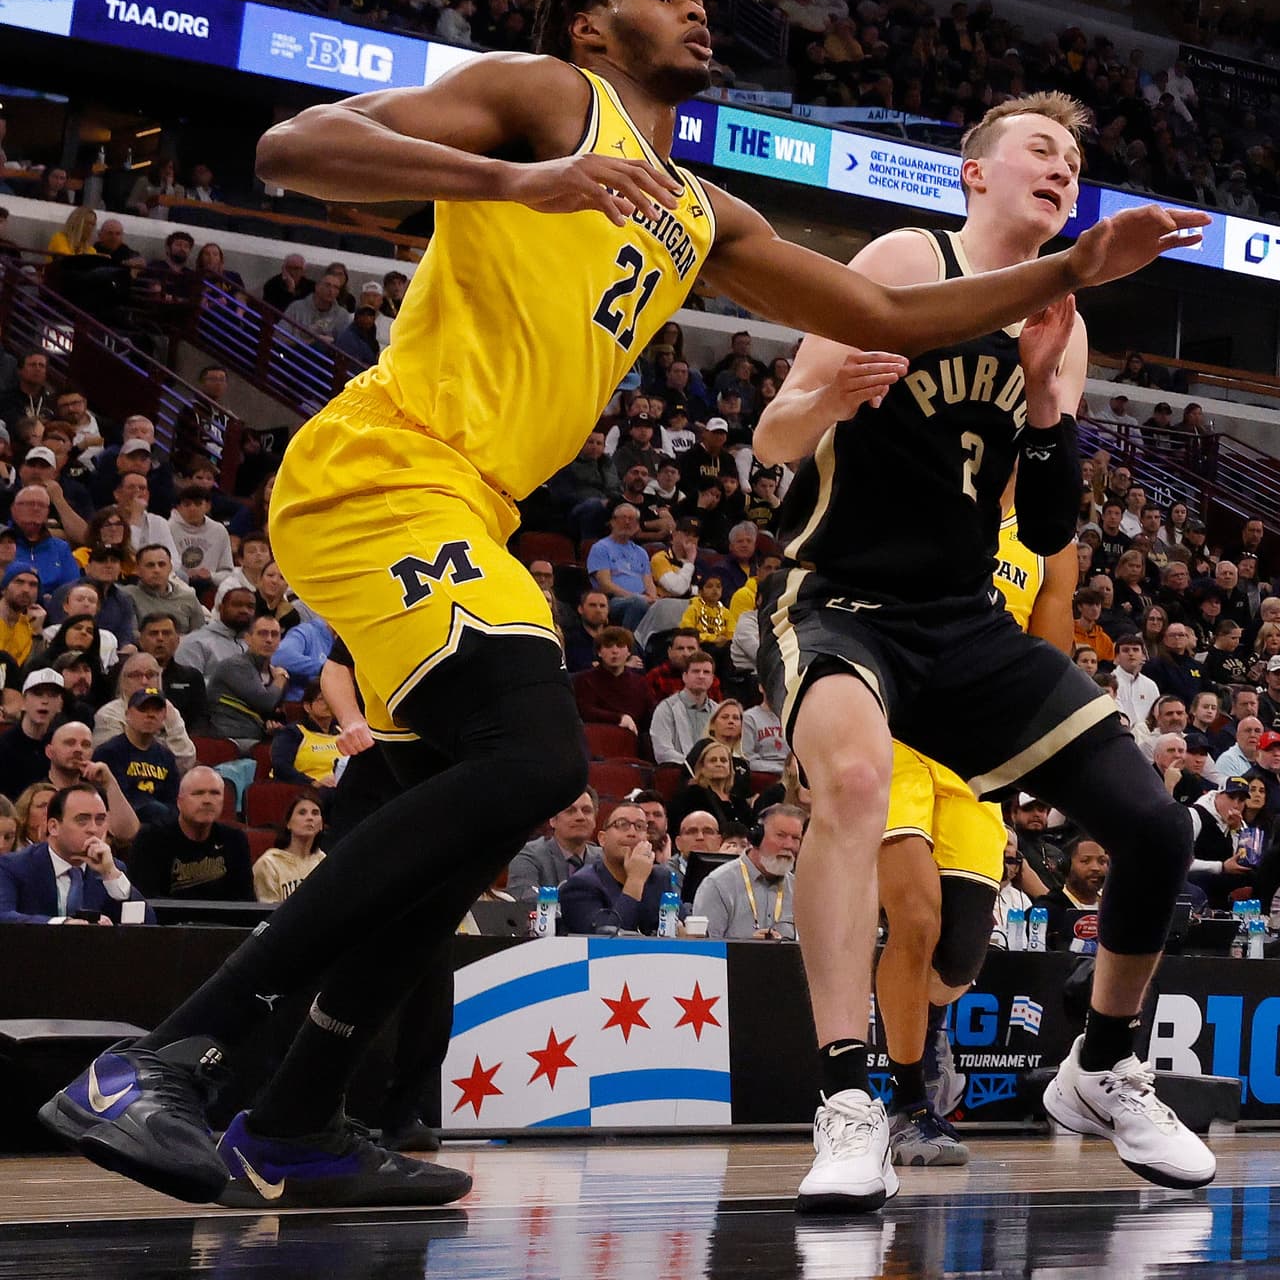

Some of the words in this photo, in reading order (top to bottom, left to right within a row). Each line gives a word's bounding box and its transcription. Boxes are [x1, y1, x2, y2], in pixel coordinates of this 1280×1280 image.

[307, 33, 394, 83] B1G
[680, 114, 701, 143] IN
[726, 122, 770, 159] THE
[773, 135, 816, 166] WIN
[871, 151, 888, 162] GET
[890, 155, 896, 163] A
[898, 156, 959, 177] GUARANTEED
[869, 175, 899, 189] CHECK
[901, 182, 918, 193] FOR
[870, 163, 915, 180] MONTHLY
[917, 173, 960, 190] RETIREME
[593, 244, 662, 352] 21
[959, 430, 986, 503] 2
[389, 540, 485, 610] M
[960, 1054, 1042, 1067] TOURNAMENT
